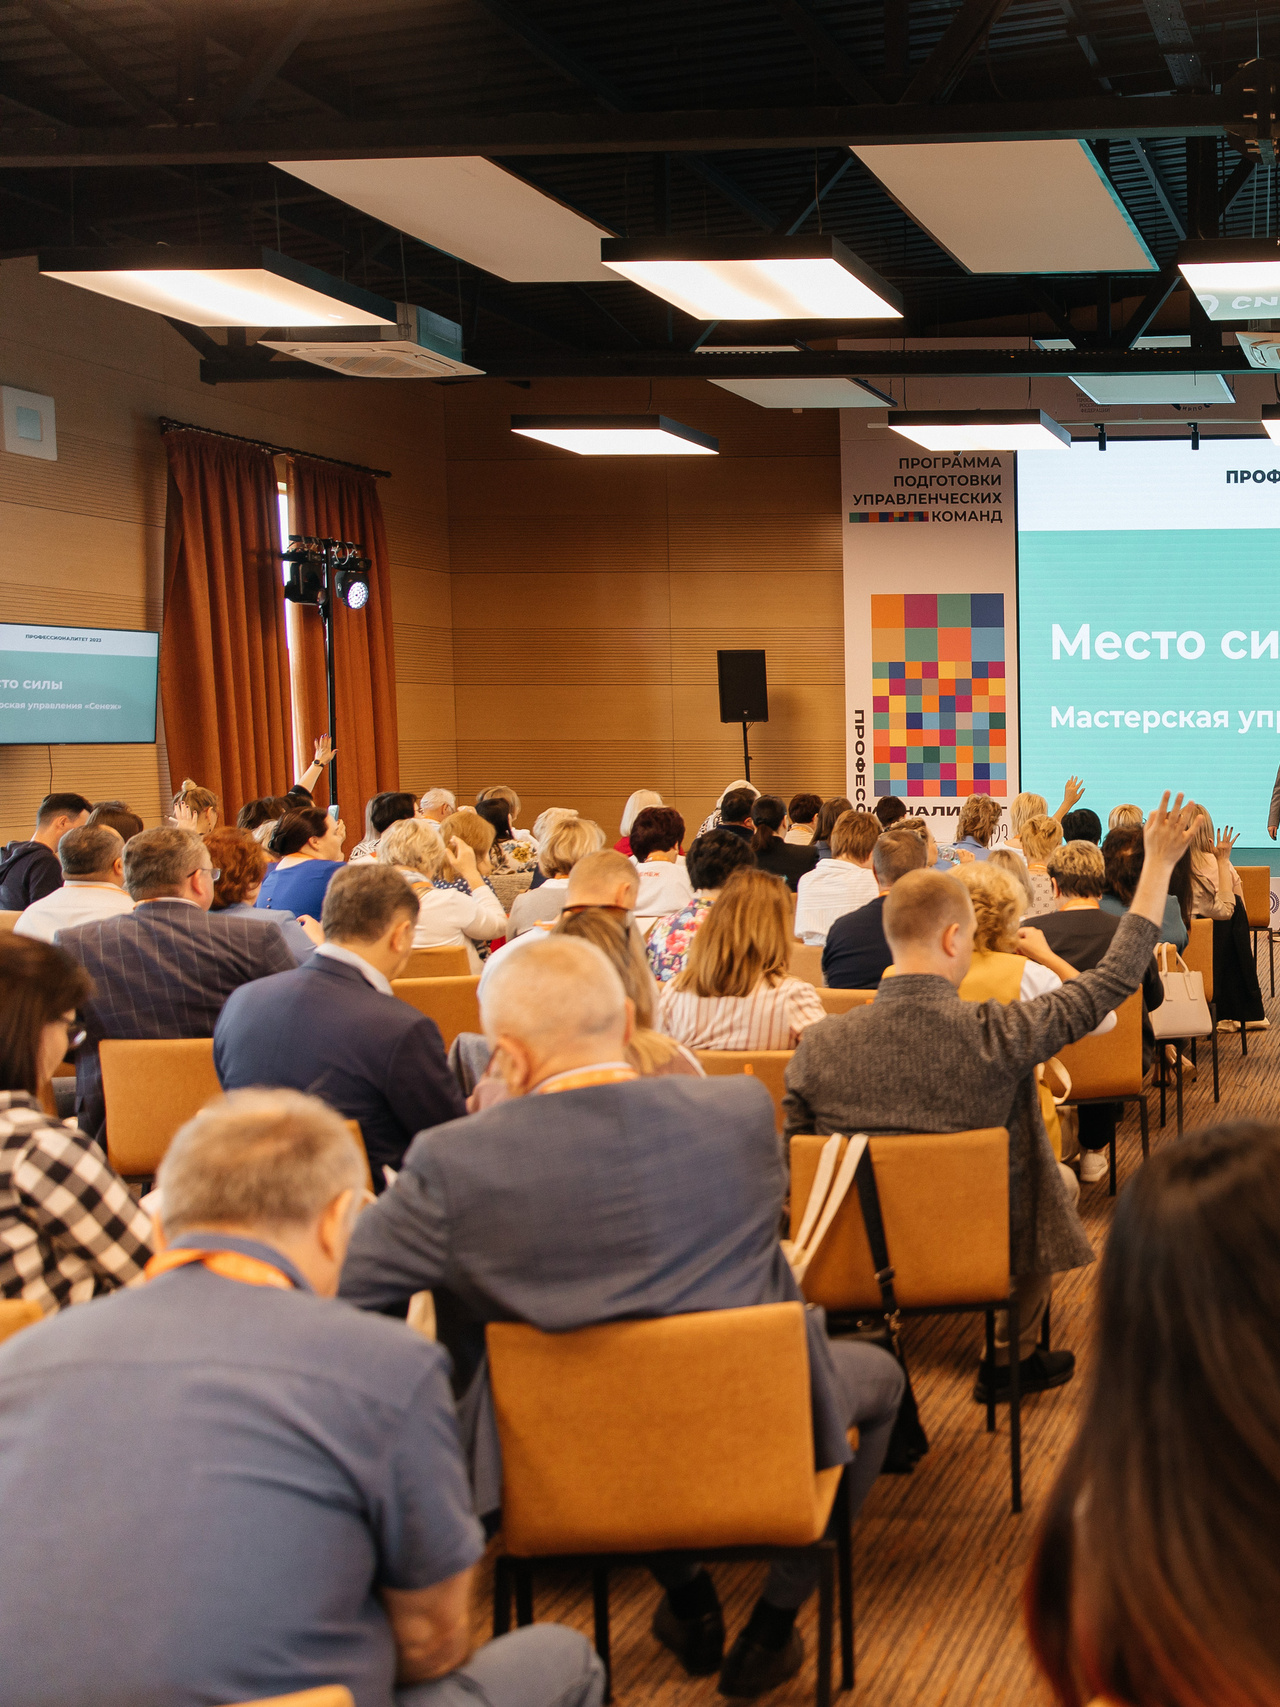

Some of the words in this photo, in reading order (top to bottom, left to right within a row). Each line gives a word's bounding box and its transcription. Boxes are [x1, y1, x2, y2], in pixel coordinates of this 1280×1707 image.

[899, 457, 1002, 470] ПРОГРАММА
[894, 474, 1002, 488] ПОДГОТОВКИ
[853, 493, 1003, 506] УПРАВЛЕНЧЕСКИХ
[931, 510, 1003, 524] КОМАНД
[1052, 623, 1206, 661] Место
[23, 680, 63, 690] силы
[27, 702, 83, 711] управления
[1051, 705, 1229, 735] Мастерская
